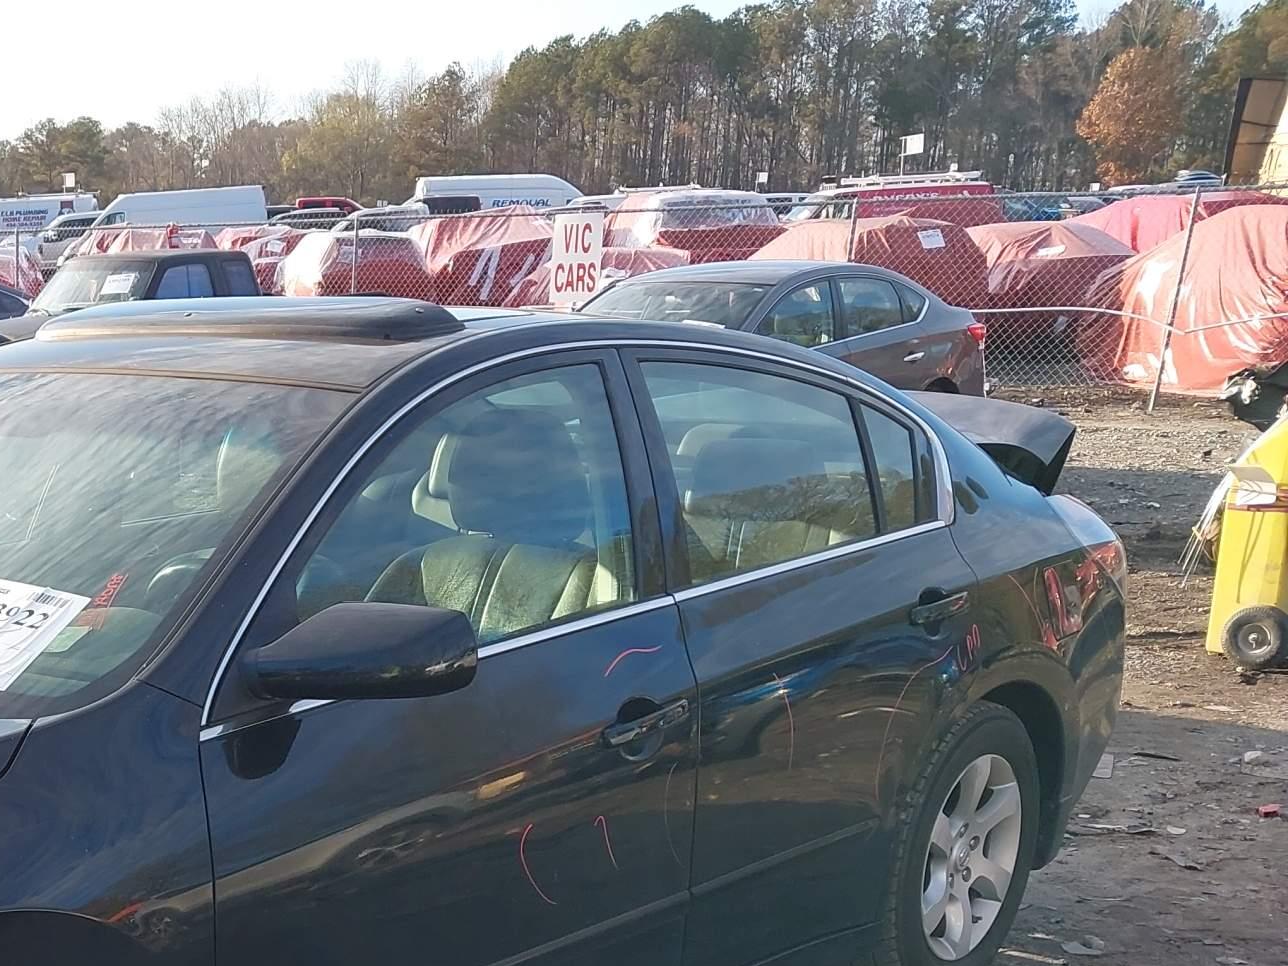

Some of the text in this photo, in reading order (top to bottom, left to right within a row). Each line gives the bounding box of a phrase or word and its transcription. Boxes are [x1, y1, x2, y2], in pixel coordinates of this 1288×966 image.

[492, 198, 552, 208] REMOVAL
[564, 223, 593, 254] VIC
[554, 262, 597, 293] CARS
